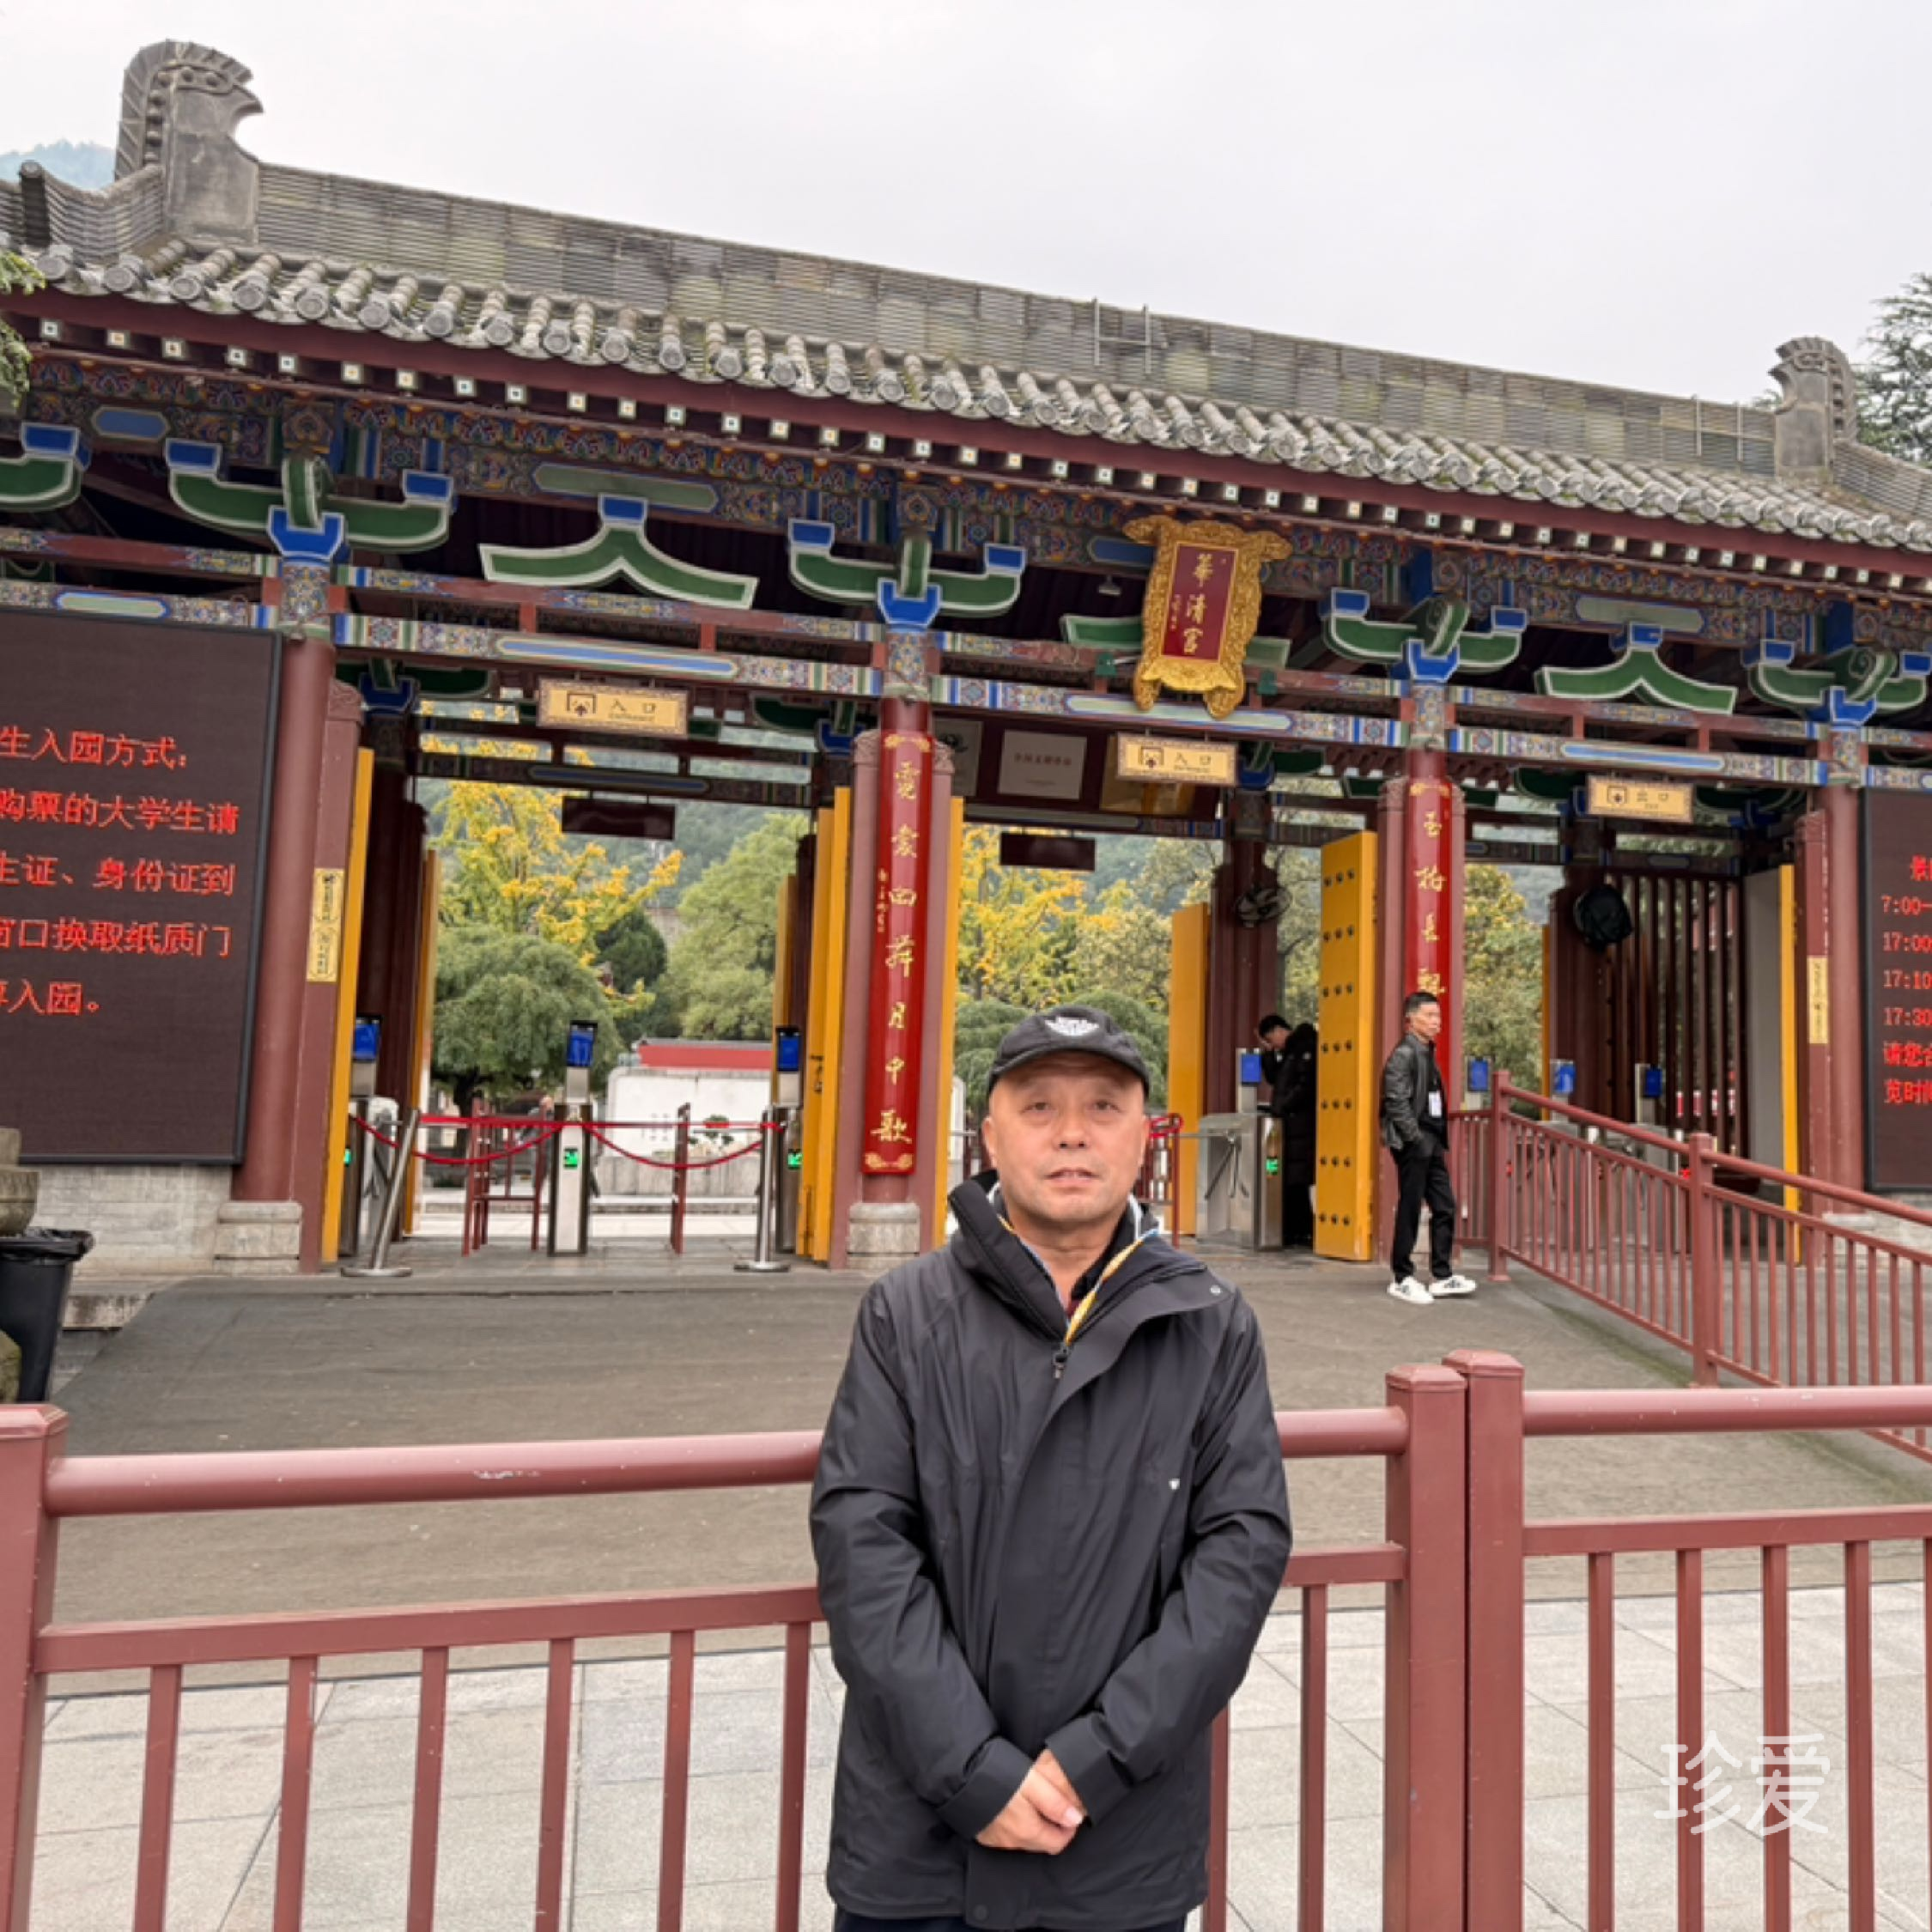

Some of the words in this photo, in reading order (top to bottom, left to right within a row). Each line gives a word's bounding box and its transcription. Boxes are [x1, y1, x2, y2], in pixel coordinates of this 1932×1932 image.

[611, 698, 656, 714] 入口
[1174, 751, 1212, 766] 入口
[0, 981, 100, 1016] 入园。
